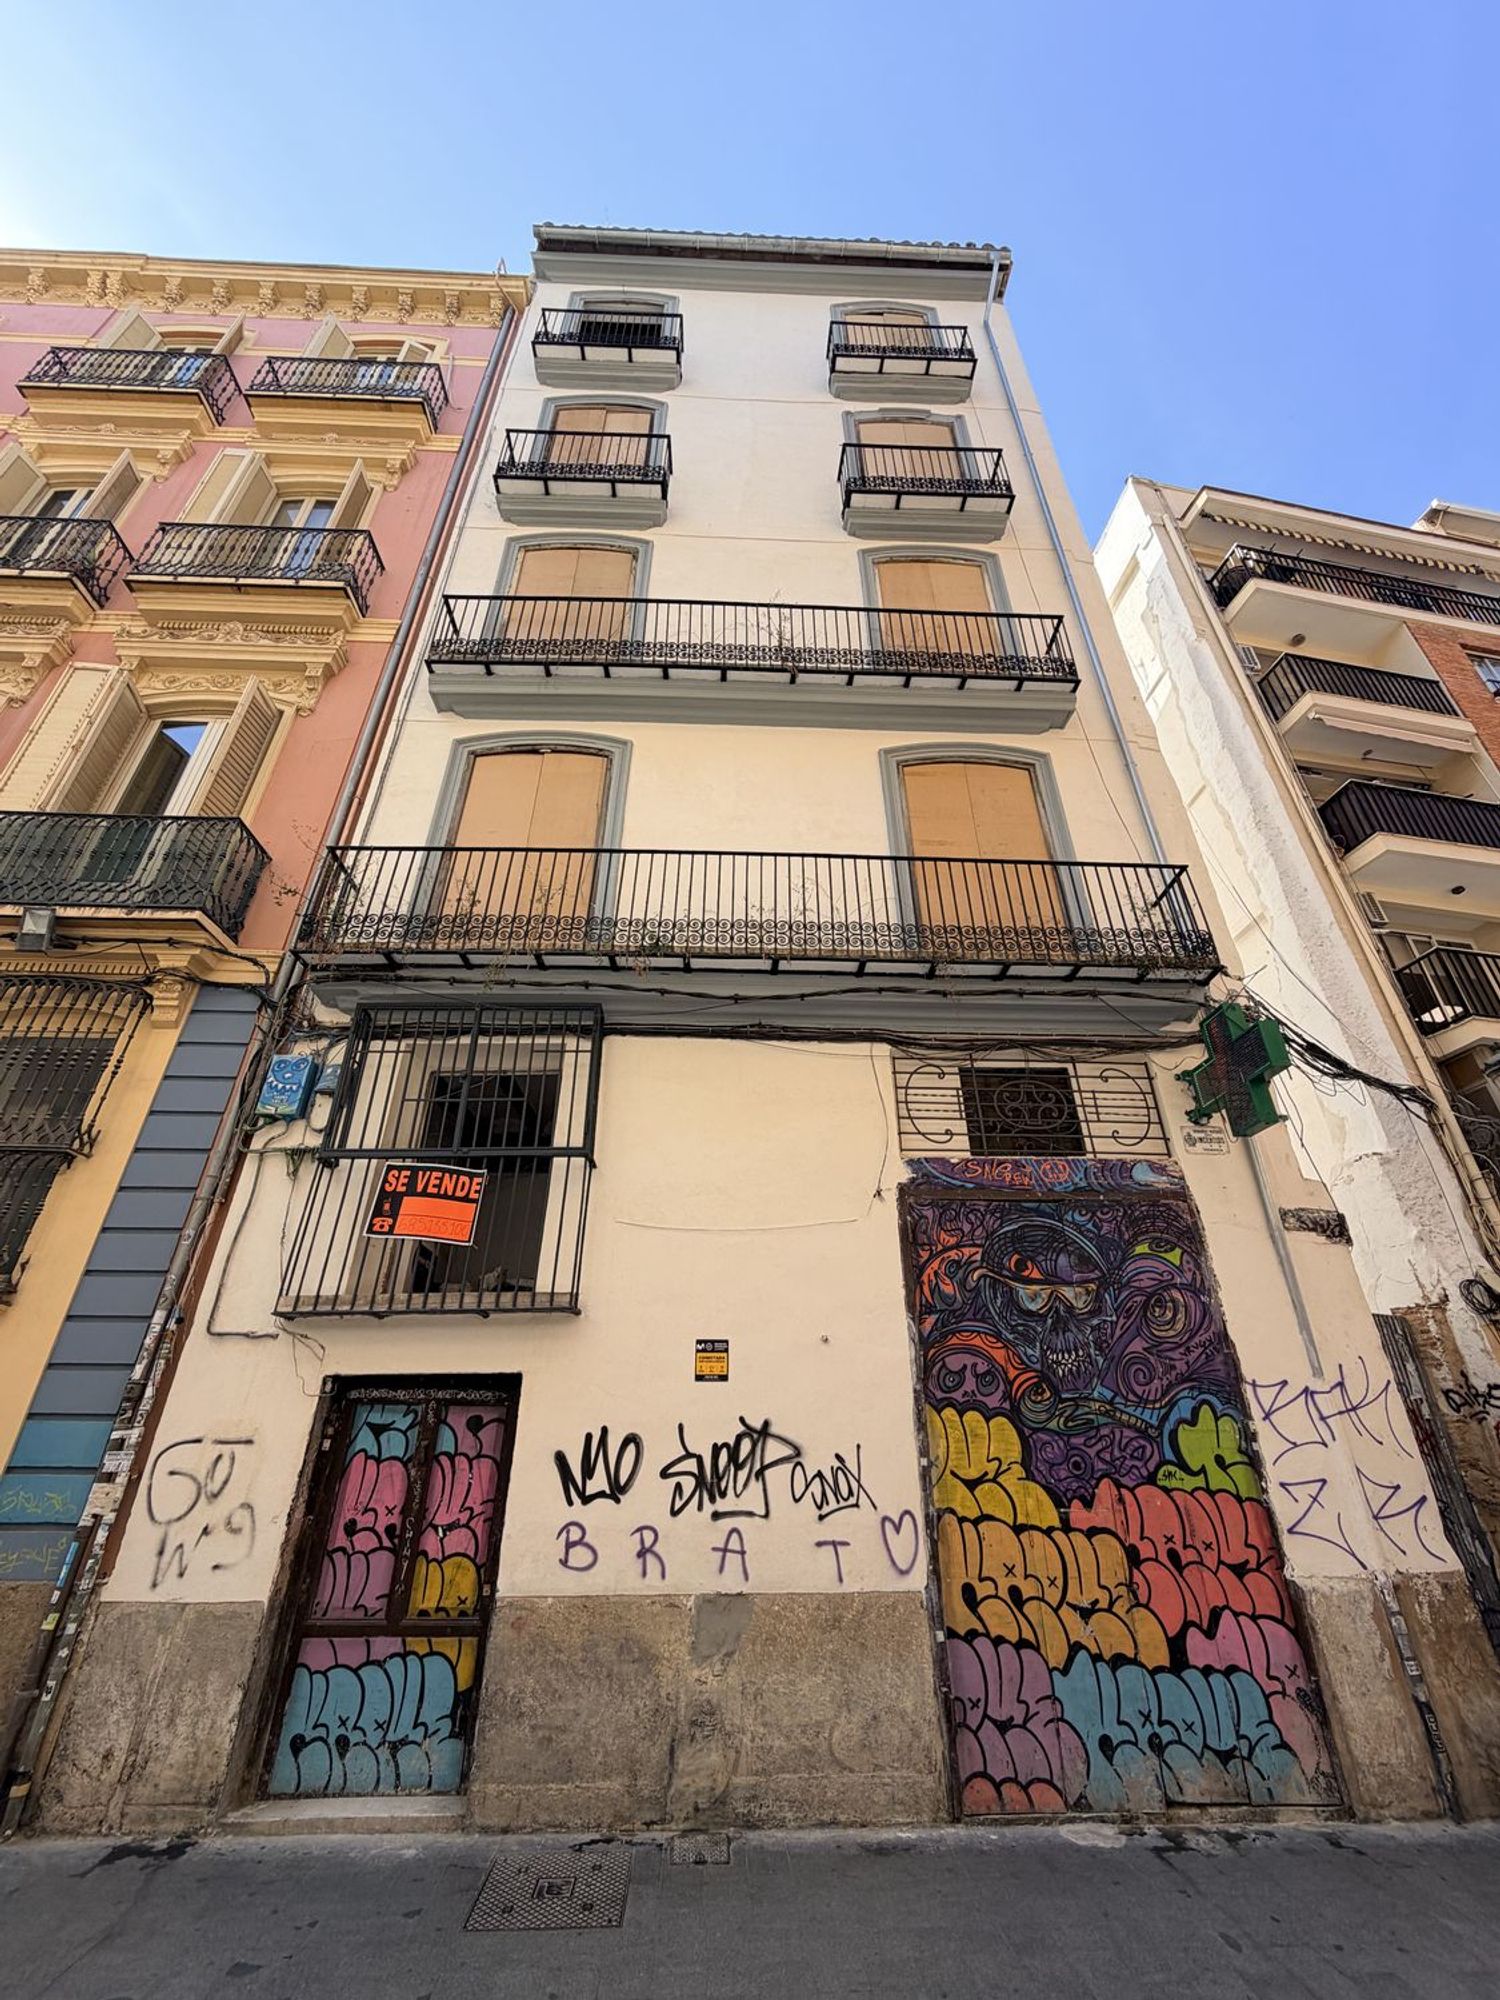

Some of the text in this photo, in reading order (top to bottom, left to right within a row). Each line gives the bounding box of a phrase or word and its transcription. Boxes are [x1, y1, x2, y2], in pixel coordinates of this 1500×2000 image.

[384, 1169, 483, 1199] SE VENDE
[555, 1520, 851, 1584] BRAT
